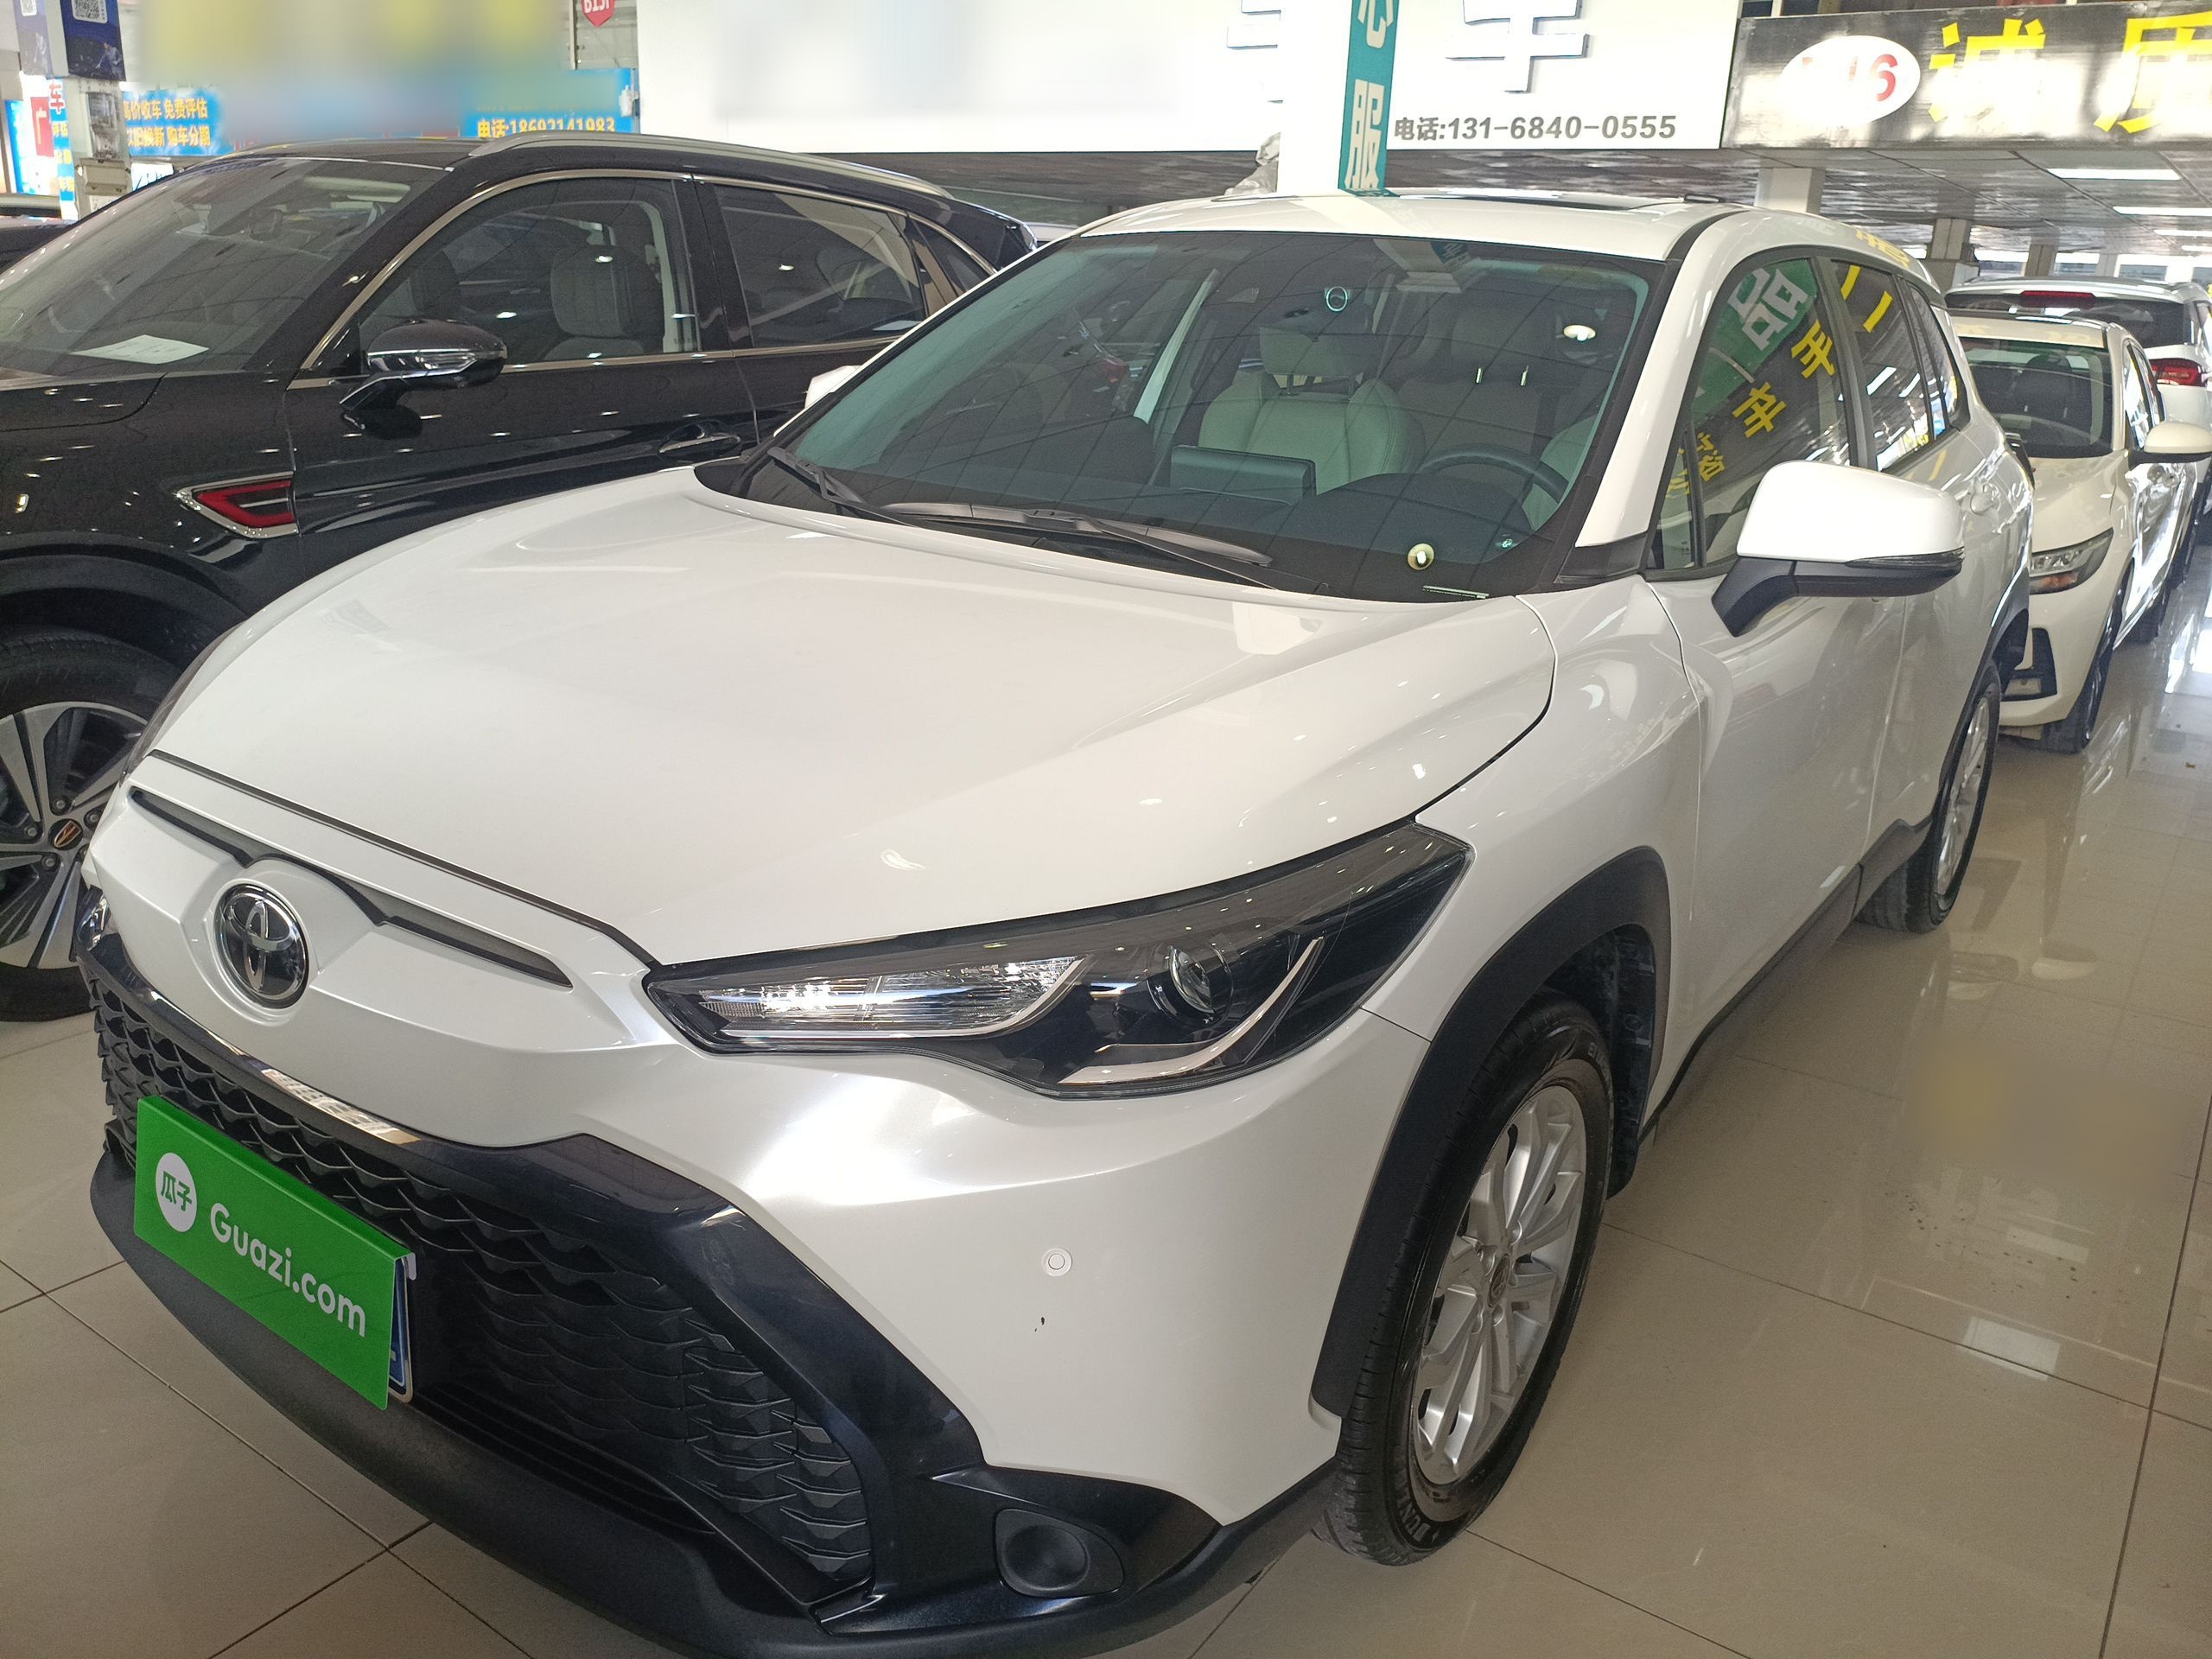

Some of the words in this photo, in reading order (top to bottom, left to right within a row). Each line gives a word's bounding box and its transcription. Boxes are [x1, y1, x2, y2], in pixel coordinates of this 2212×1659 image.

[163, 97, 208, 119] 免费评估
[1393, 114, 1677, 141] 电话:131-6840-0555
[160, 1171, 193, 1211] 瓜子
[210, 1203, 366, 1338] Guazi.com
